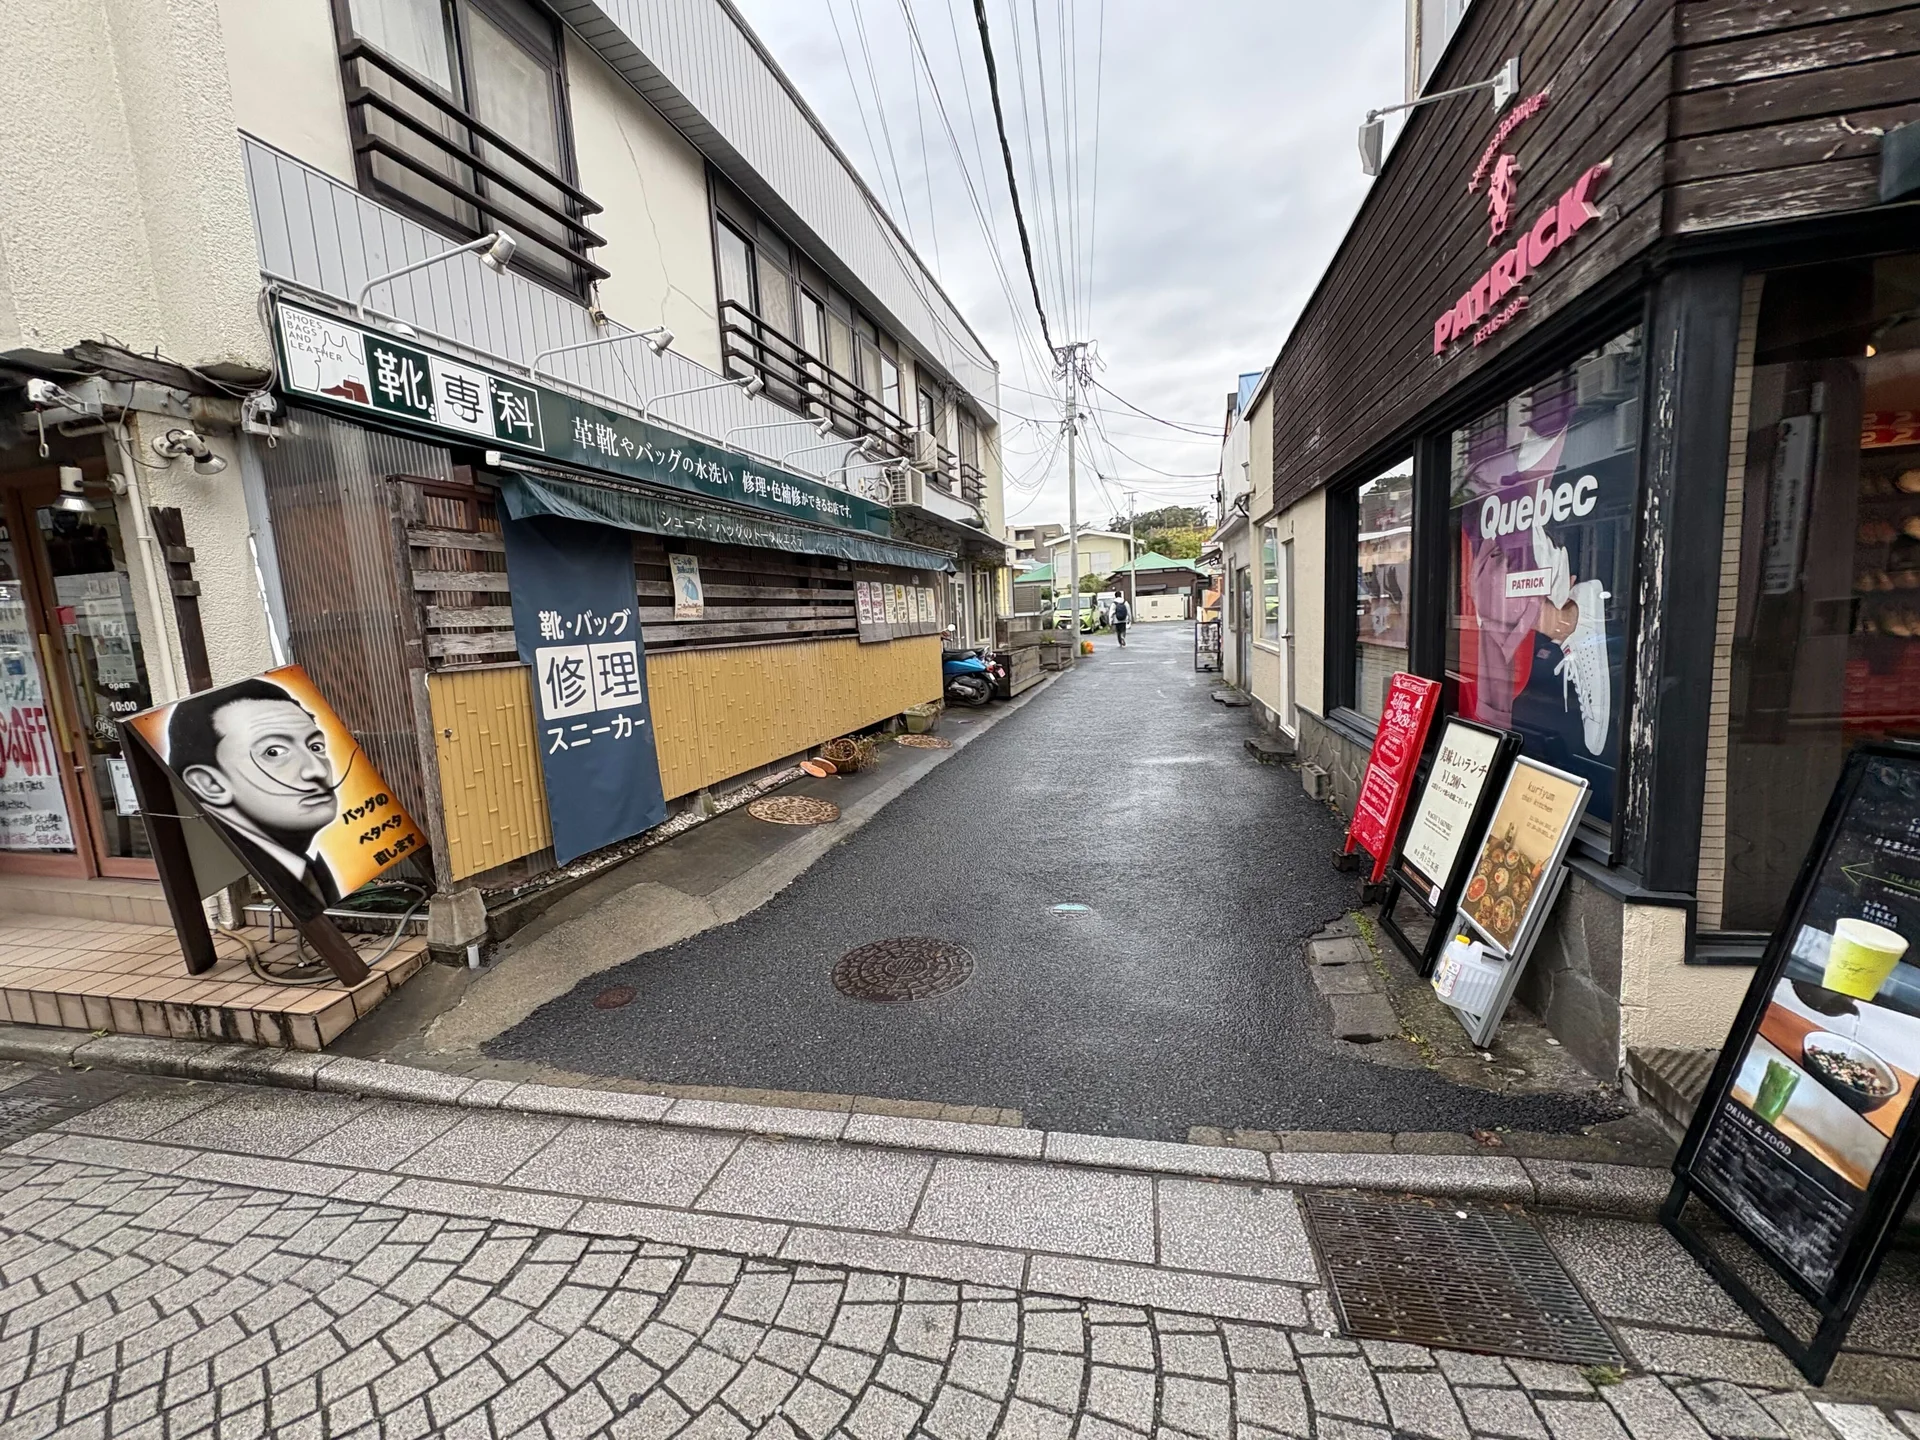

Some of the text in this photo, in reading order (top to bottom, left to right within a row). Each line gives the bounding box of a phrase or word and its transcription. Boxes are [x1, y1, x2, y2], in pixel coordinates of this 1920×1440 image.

[1434, 162, 1604, 355] PATRICK
[286, 311, 322, 330] SHOES
[287, 320, 317, 337] BAGS
[289, 331, 312, 343] AND
[290, 339, 343, 363] LEATHER
[373, 347, 535, 439] 靴専科
[571, 416, 852, 519] 革靴やバッグの水洗い 修理・色補修ができるお店です。
[1480, 474, 1598, 540] Quebec
[1511, 577, 1545, 590] PATRICK
[538, 608, 632, 641] 靴・バッグ
[108, 682, 131, 691] open
[545, 651, 640, 710] 修理
[109, 700, 137, 712] 10:00
[547, 713, 645, 755] スニーカー
[1440, 746, 1487, 779] 美味しいランチ
[342, 793, 389, 825] バッグの
[373, 833, 416, 867] 直します
[1725, 1102, 1758, 1128] DRINK
[1763, 1130, 1792, 1156] FOOD
